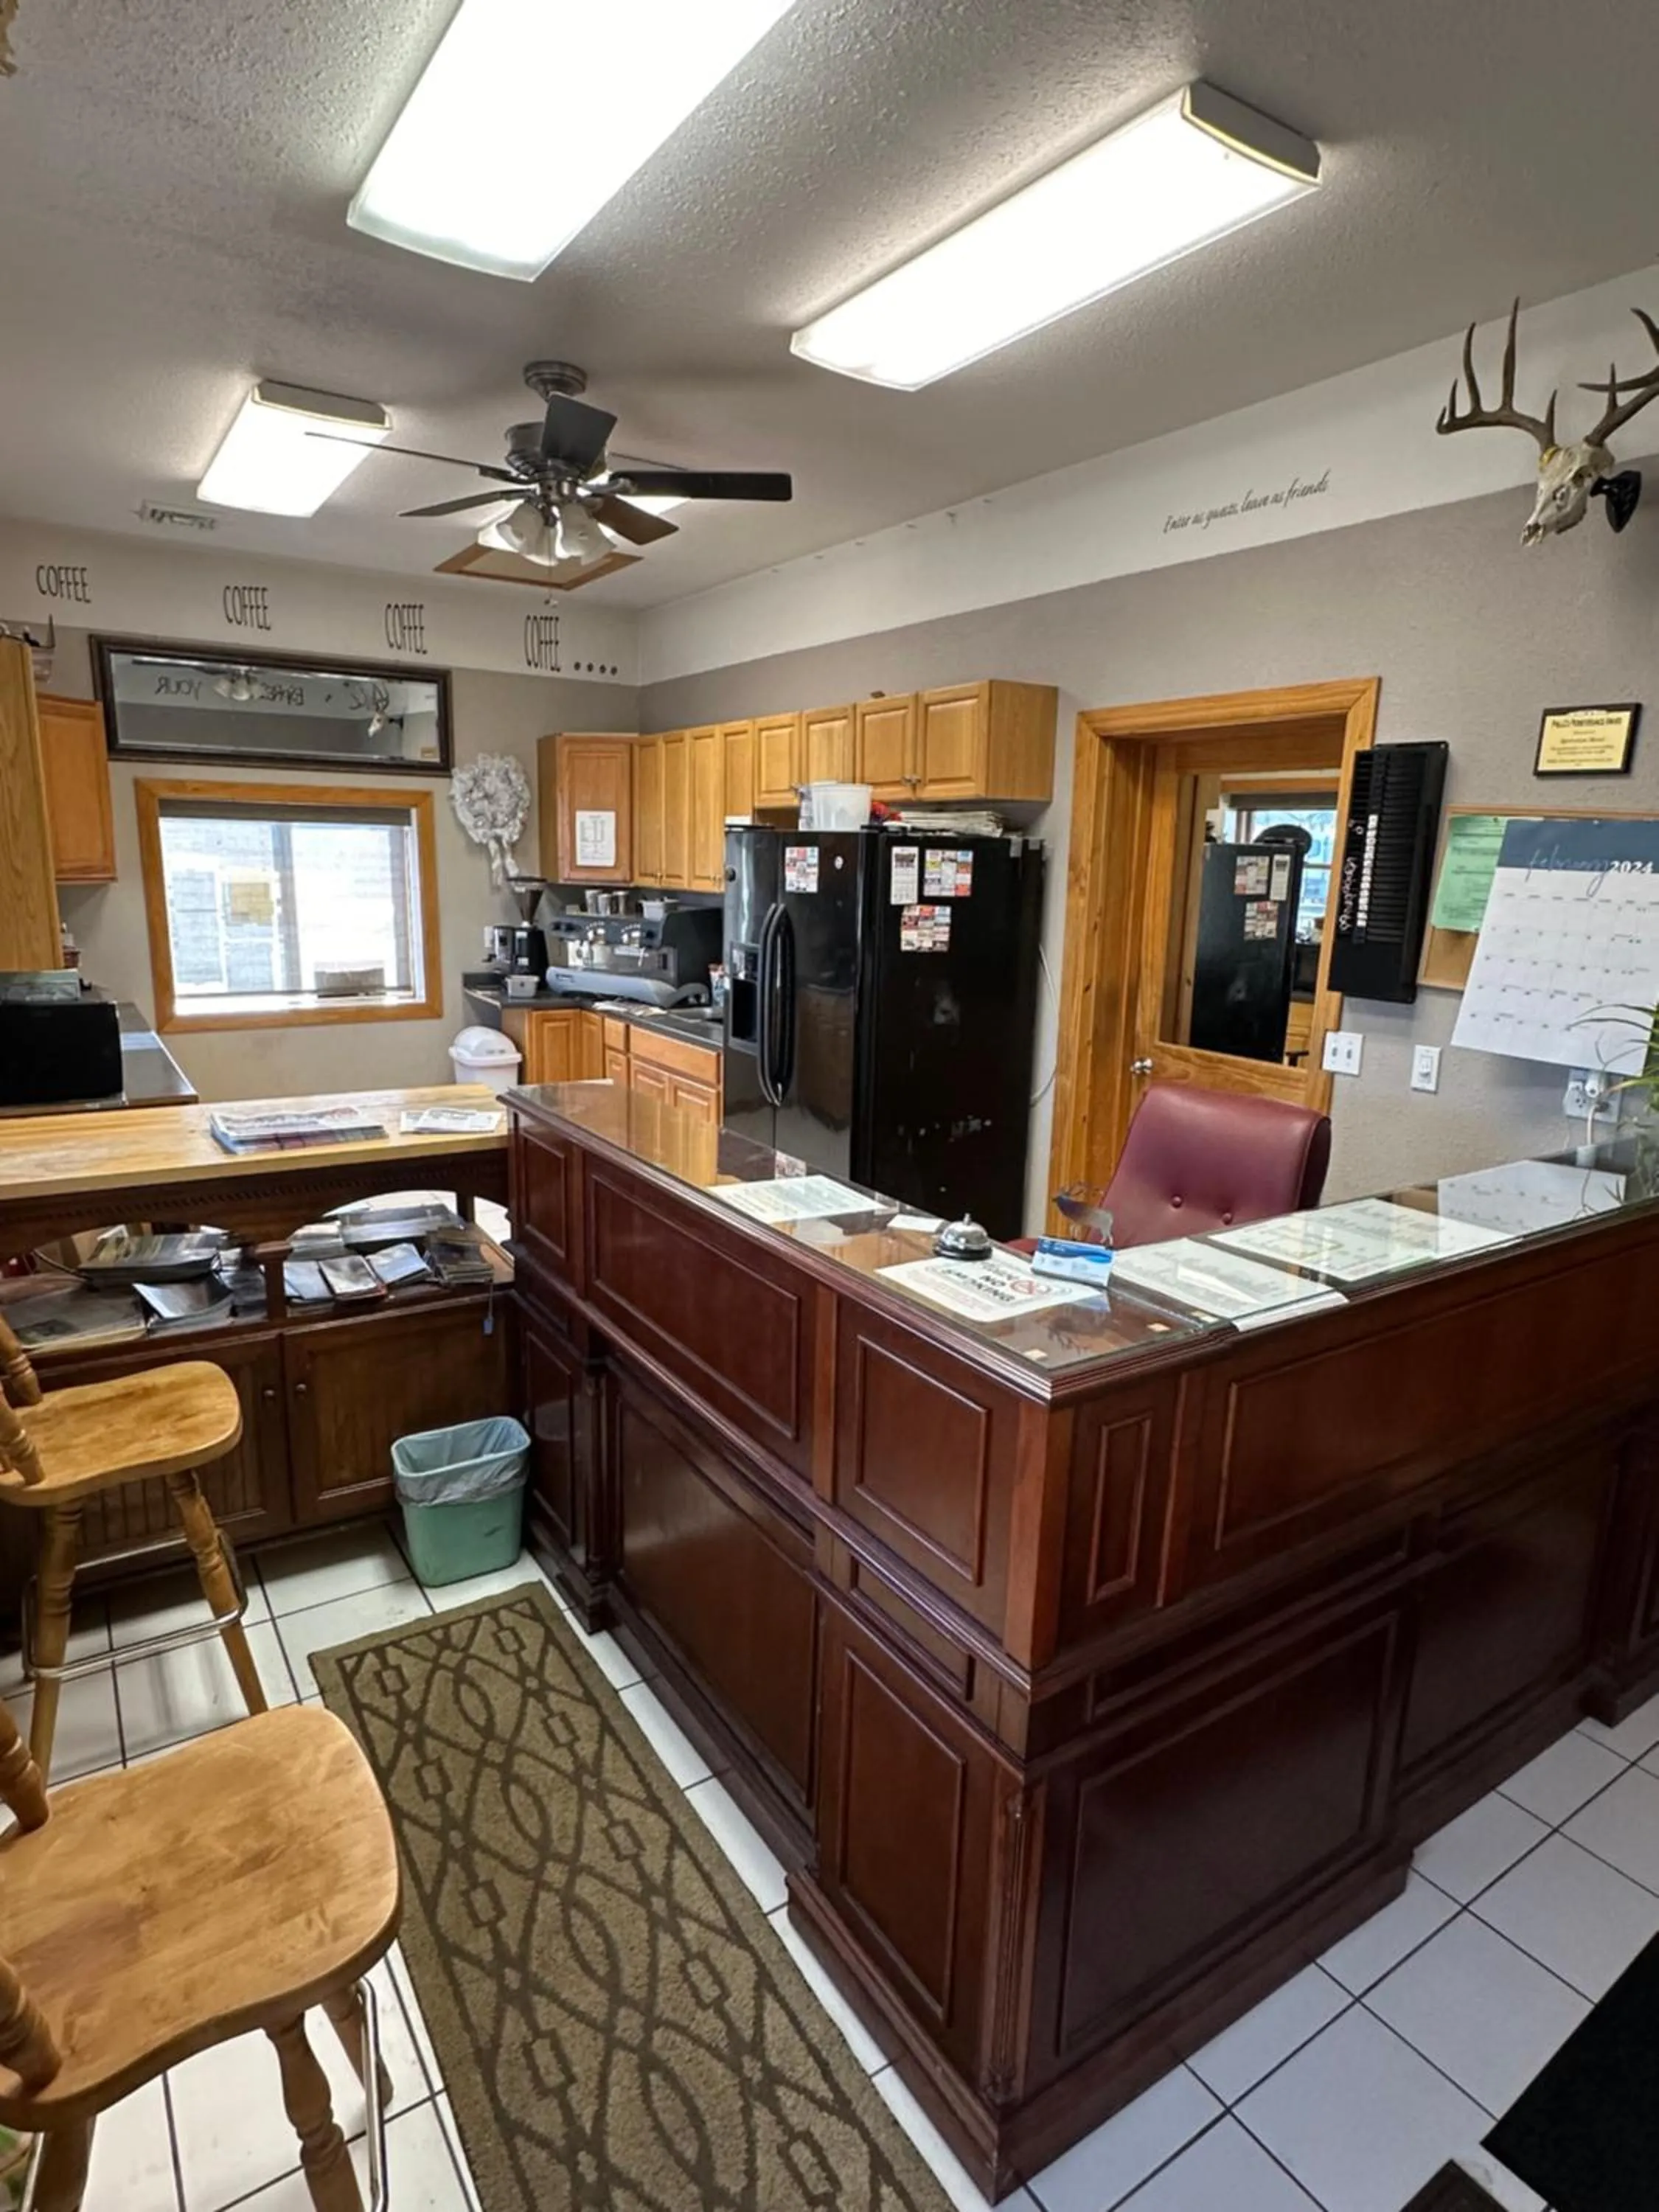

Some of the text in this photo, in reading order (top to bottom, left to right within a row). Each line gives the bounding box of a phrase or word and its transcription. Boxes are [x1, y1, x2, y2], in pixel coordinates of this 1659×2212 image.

[1192, 512, 1205, 525] as
[1241, 489, 1269, 512] leave
[1270, 492, 1284, 504] as
[1283, 468, 1331, 509] friends
[35, 565, 91, 604] COFFEE
[223, 585, 272, 630] COFFEE
[385, 604, 428, 654] COFFEE
[524, 615, 561, 672] COFFEE
[1525, 844, 1654, 897] february 2024
